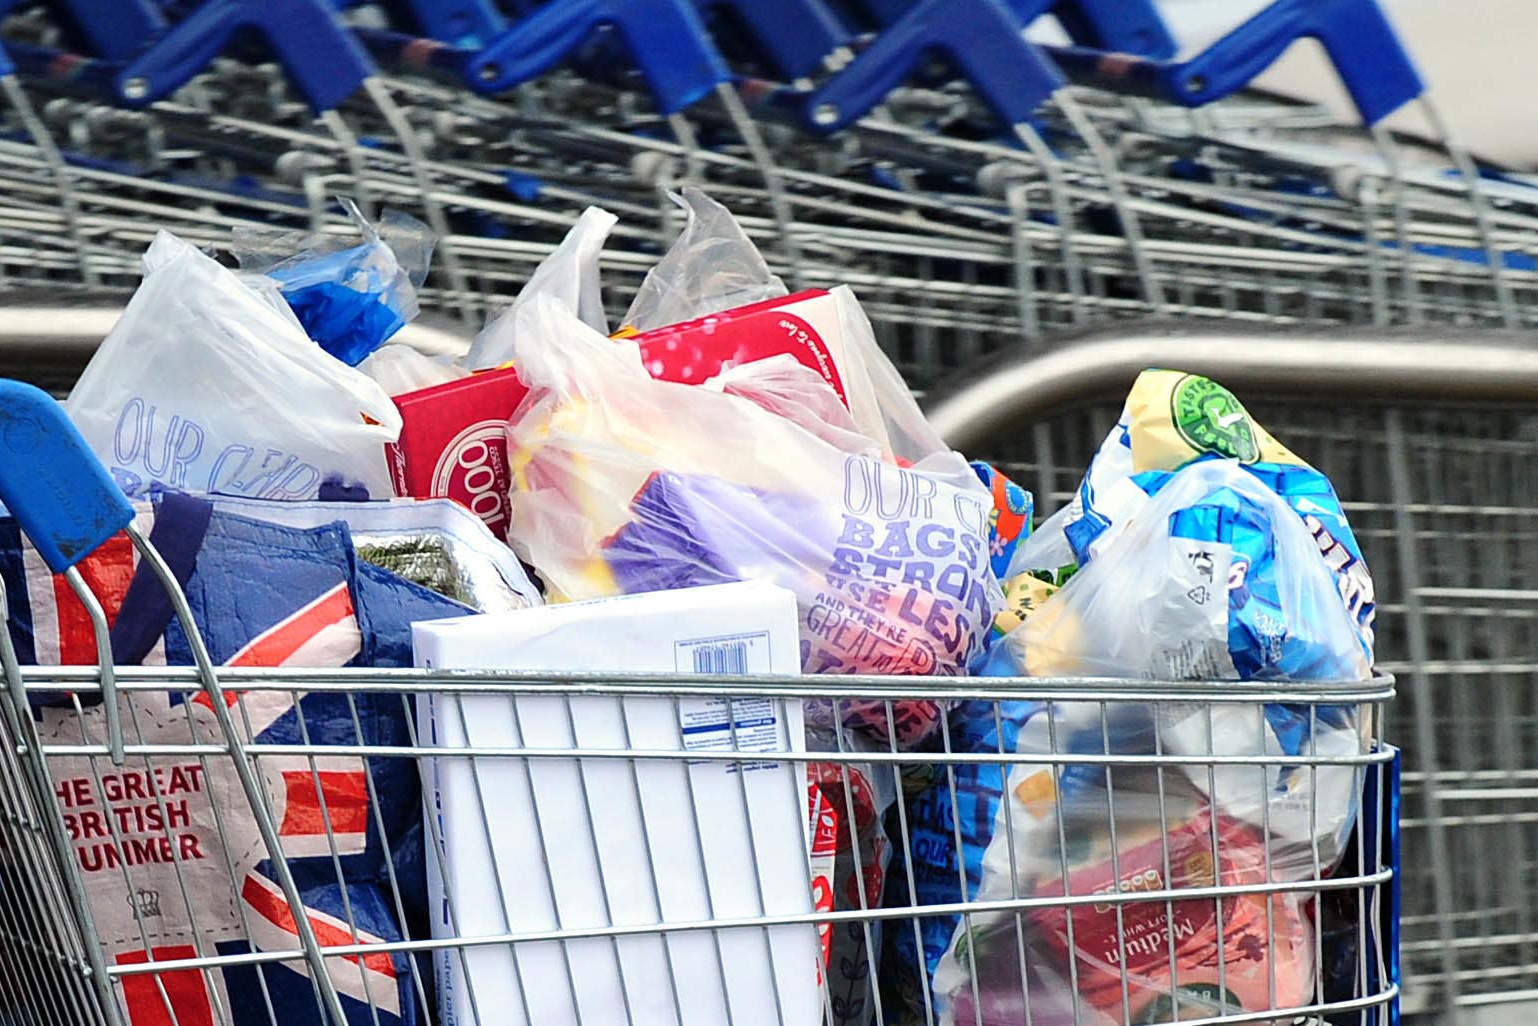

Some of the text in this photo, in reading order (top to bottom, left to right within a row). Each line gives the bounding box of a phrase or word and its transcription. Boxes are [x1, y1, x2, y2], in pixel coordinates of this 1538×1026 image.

[114, 396, 205, 489] OUR
[843, 454, 937, 521] OUR
[837, 513, 981, 571] BAGS
[815, 592, 845, 613] AND
[806, 604, 898, 663] GREAT
[53, 764, 203, 808] HE GREAT
[74, 833, 206, 873] UMMER
[443, 949, 453, 990] pape
